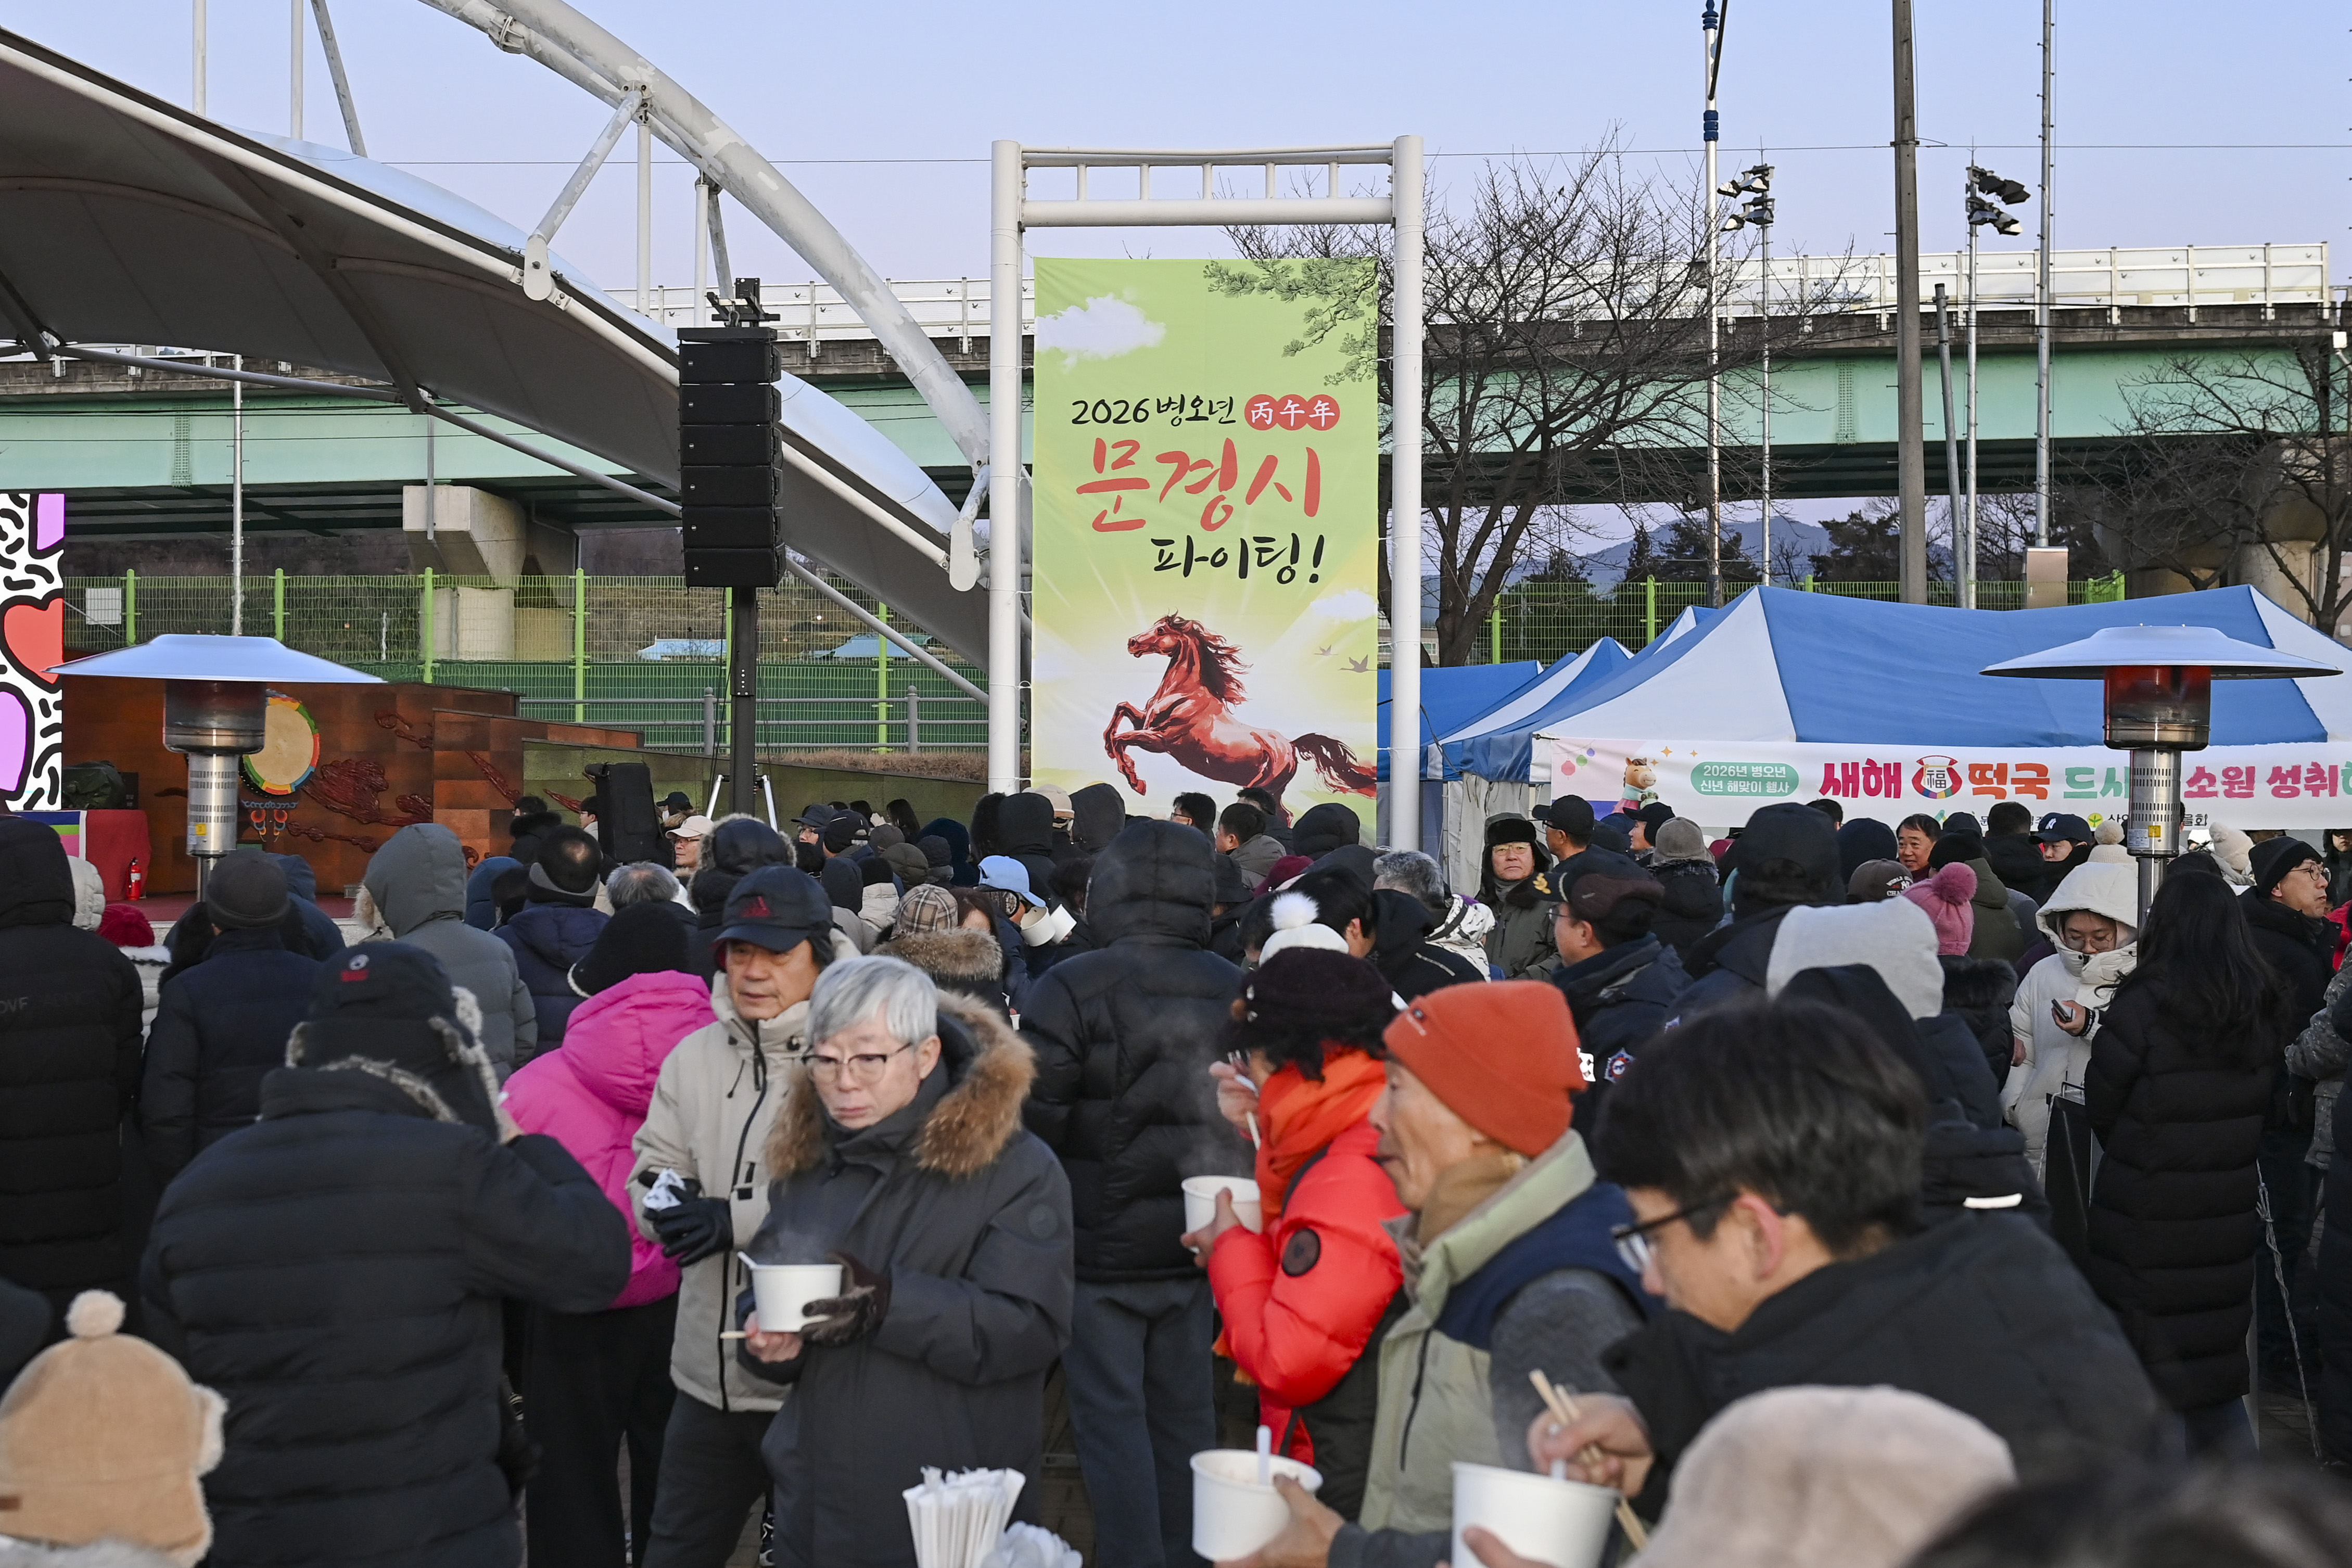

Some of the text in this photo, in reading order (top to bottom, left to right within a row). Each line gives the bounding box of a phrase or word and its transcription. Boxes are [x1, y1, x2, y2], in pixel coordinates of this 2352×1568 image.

[1072, 393, 1336, 428] 2026 병오년 丙午年
[1076, 437, 1321, 532] 문경시
[1151, 532, 1324, 584] 파이팅!
[1700, 780, 1790, 793] 신년 해맞이 행사
[1703, 765, 1786, 778] 2026년 병오년
[1819, 758, 1902, 799] 새해
[1968, 763, 2050, 800] 떡국
[2064, 767, 2130, 798] 드시
[2184, 766, 2256, 798] 소원
